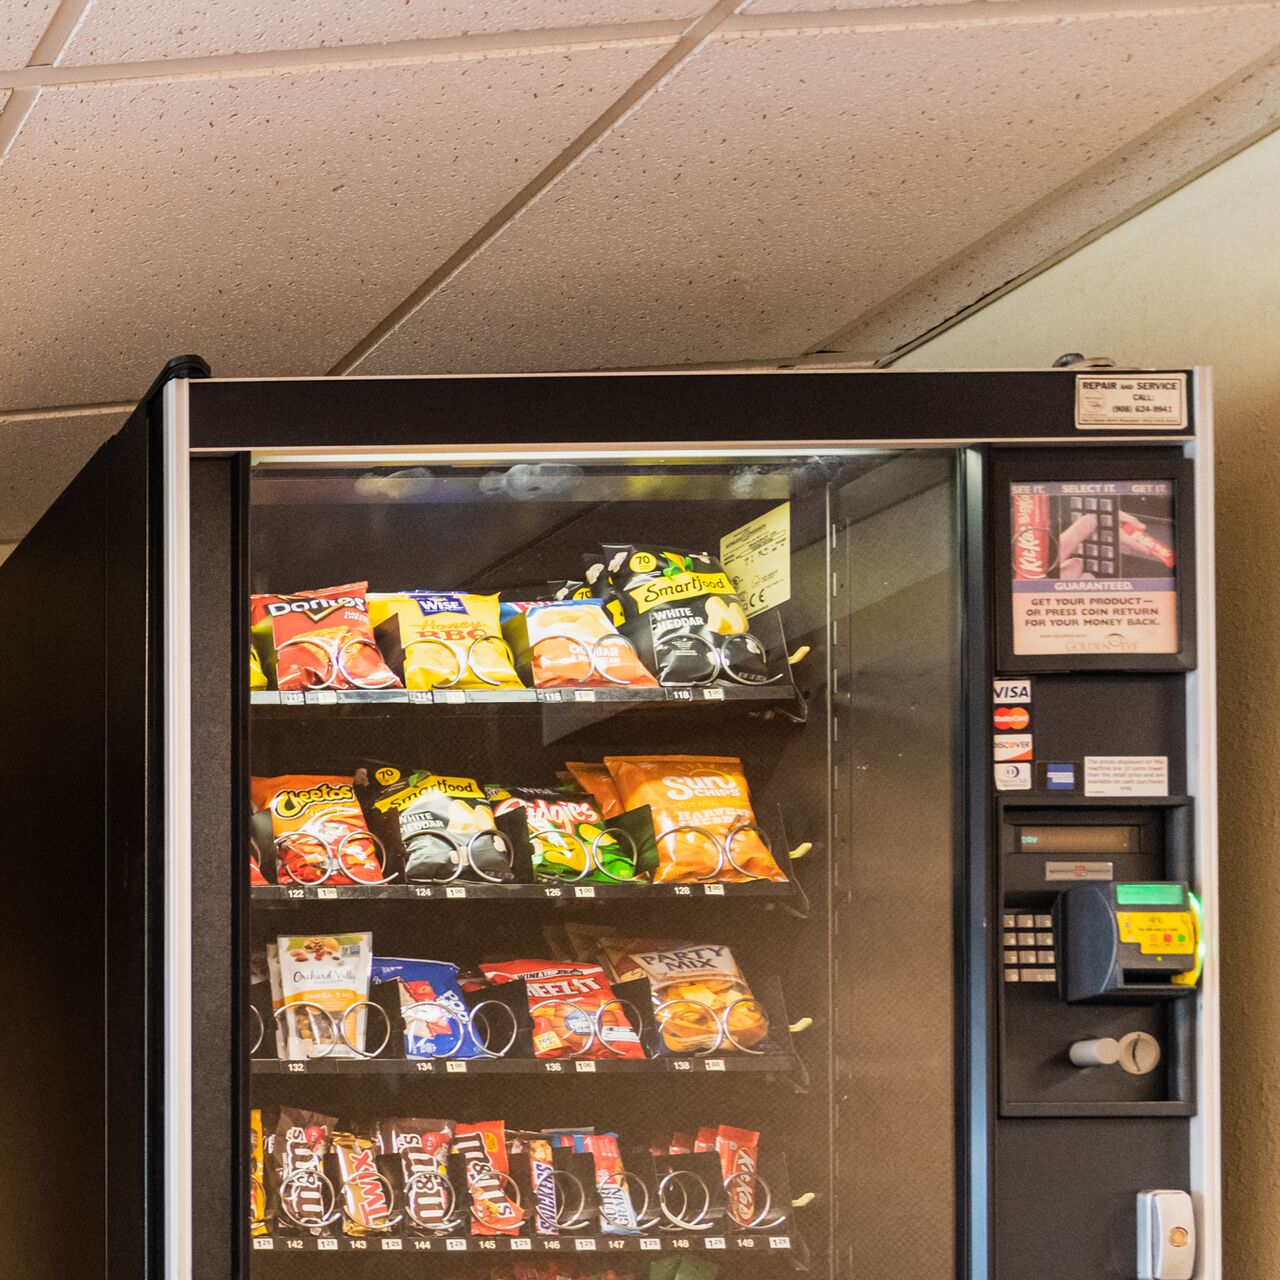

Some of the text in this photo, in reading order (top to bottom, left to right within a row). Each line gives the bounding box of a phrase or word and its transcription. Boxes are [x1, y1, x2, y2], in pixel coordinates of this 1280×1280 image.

[1082, 381, 1117, 390] REPAIR
[1137, 382, 1177, 390] SERVICE
[1062, 484, 1103, 493] SELECT
[1131, 484, 1154, 493] GET
[636, 556, 650, 565] 70
[643, 575, 726, 603] Smartfood
[1054, 581, 1134, 591] GUARANTEED.
[1031, 597, 1141, 606] GET YOUR PRODUCT
[653, 607, 693, 620] WHITE
[1026, 607, 1159, 616] OR PRESS COIN RETURN
[1024, 619, 1046, 627] FOR
[1050, 619, 1080, 627] YOUR
[1083, 618, 1122, 626] MONEY
[416, 629, 487, 641] BBQ
[672, 690, 690, 699] 118
[994, 686, 1029, 698] VISA
[379, 769, 393, 779] 70
[662, 775, 732, 801] Sun
[276, 784, 354, 819] Cheetos
[399, 812, 434, 824] WHITE
[288, 889, 304, 898] 122
[415, 888, 431, 896] 124
[544, 888, 561, 896] 126
[673, 886, 690, 895] 128
[640, 945, 726, 965] PARTY
[666, 957, 719, 971] MIX
[293, 970, 332, 983] Orchard
[288, 1063, 304, 1072] 132
[416, 1063, 432, 1071] 134
[545, 1062, 561, 1071] 136
[673, 1061, 690, 1069] 138
[536, 1161, 558, 1234] SNICKERS
[286, 1239, 754, 1249] 142 143 144 145 146 147 148 149
